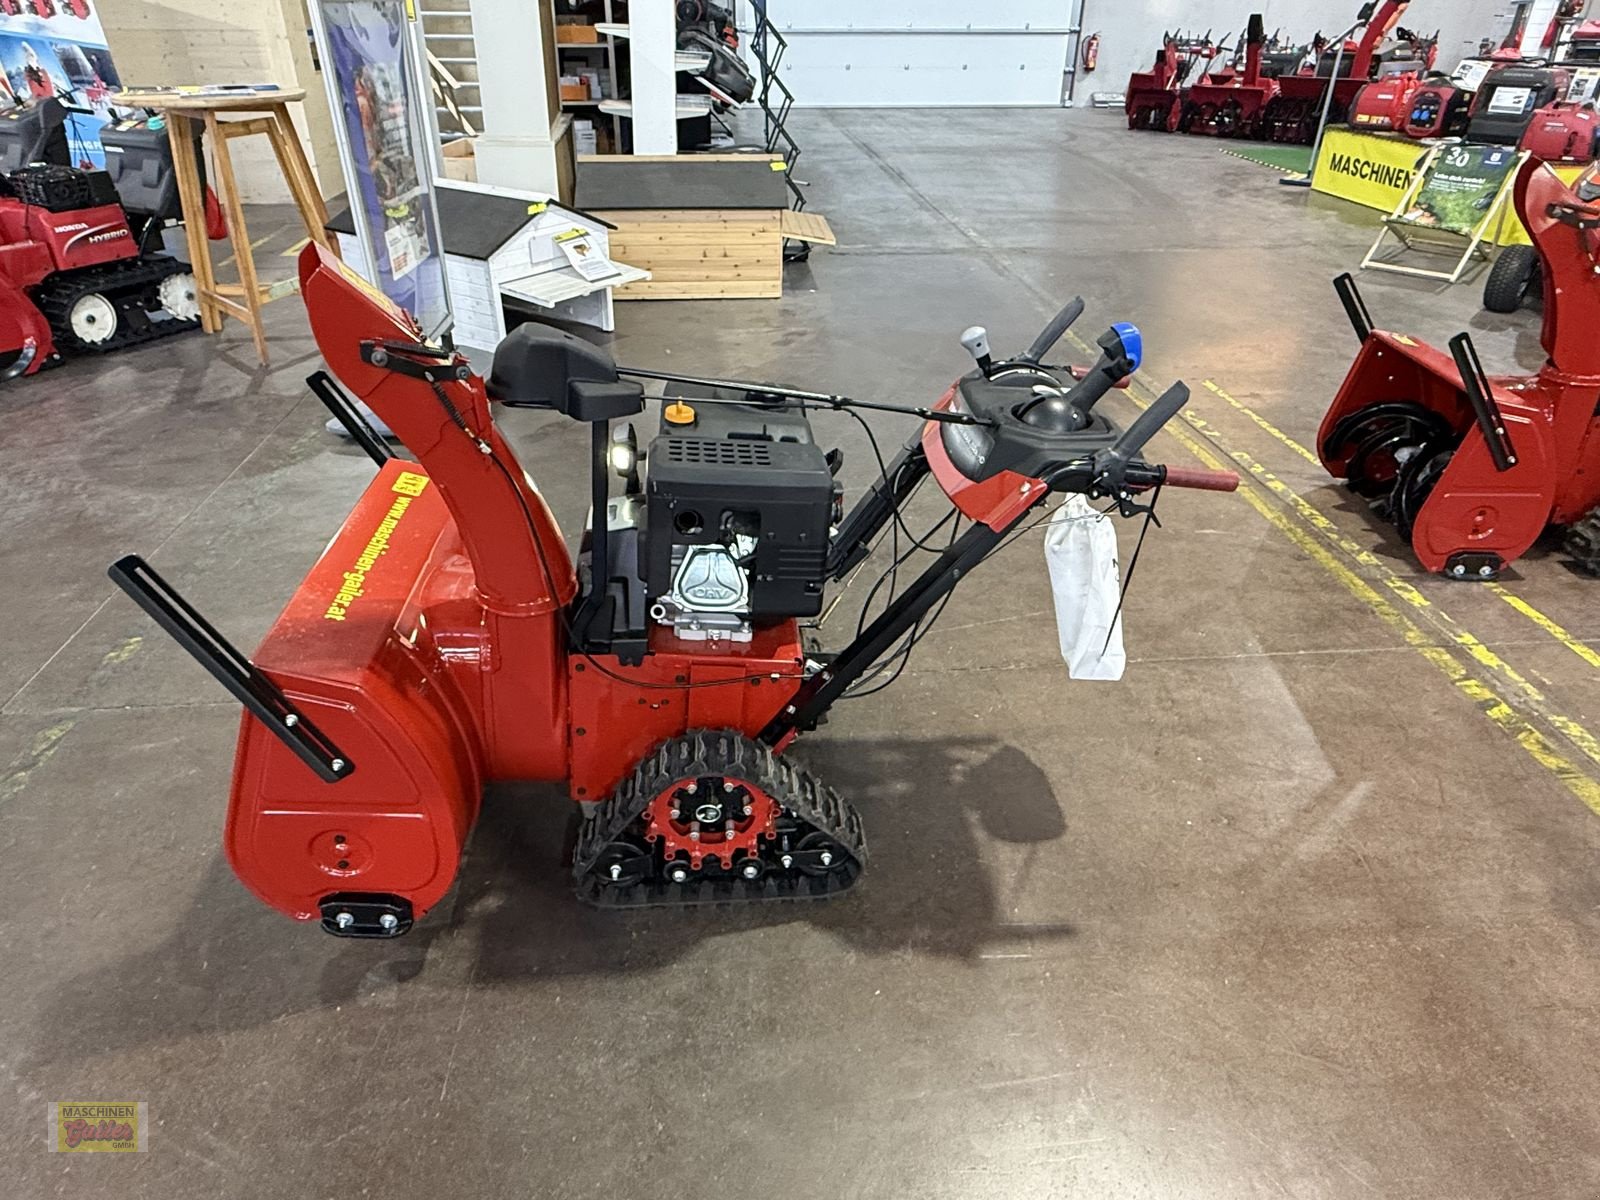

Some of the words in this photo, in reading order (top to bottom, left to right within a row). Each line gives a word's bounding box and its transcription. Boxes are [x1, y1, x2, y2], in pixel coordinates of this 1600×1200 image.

[1329, 152, 1416, 190] MASCHINEN
[54, 222, 88, 233] HONDA
[89, 229, 128, 243] HYBRID
[324, 496, 413, 621] www.maschinen-gailer.at
